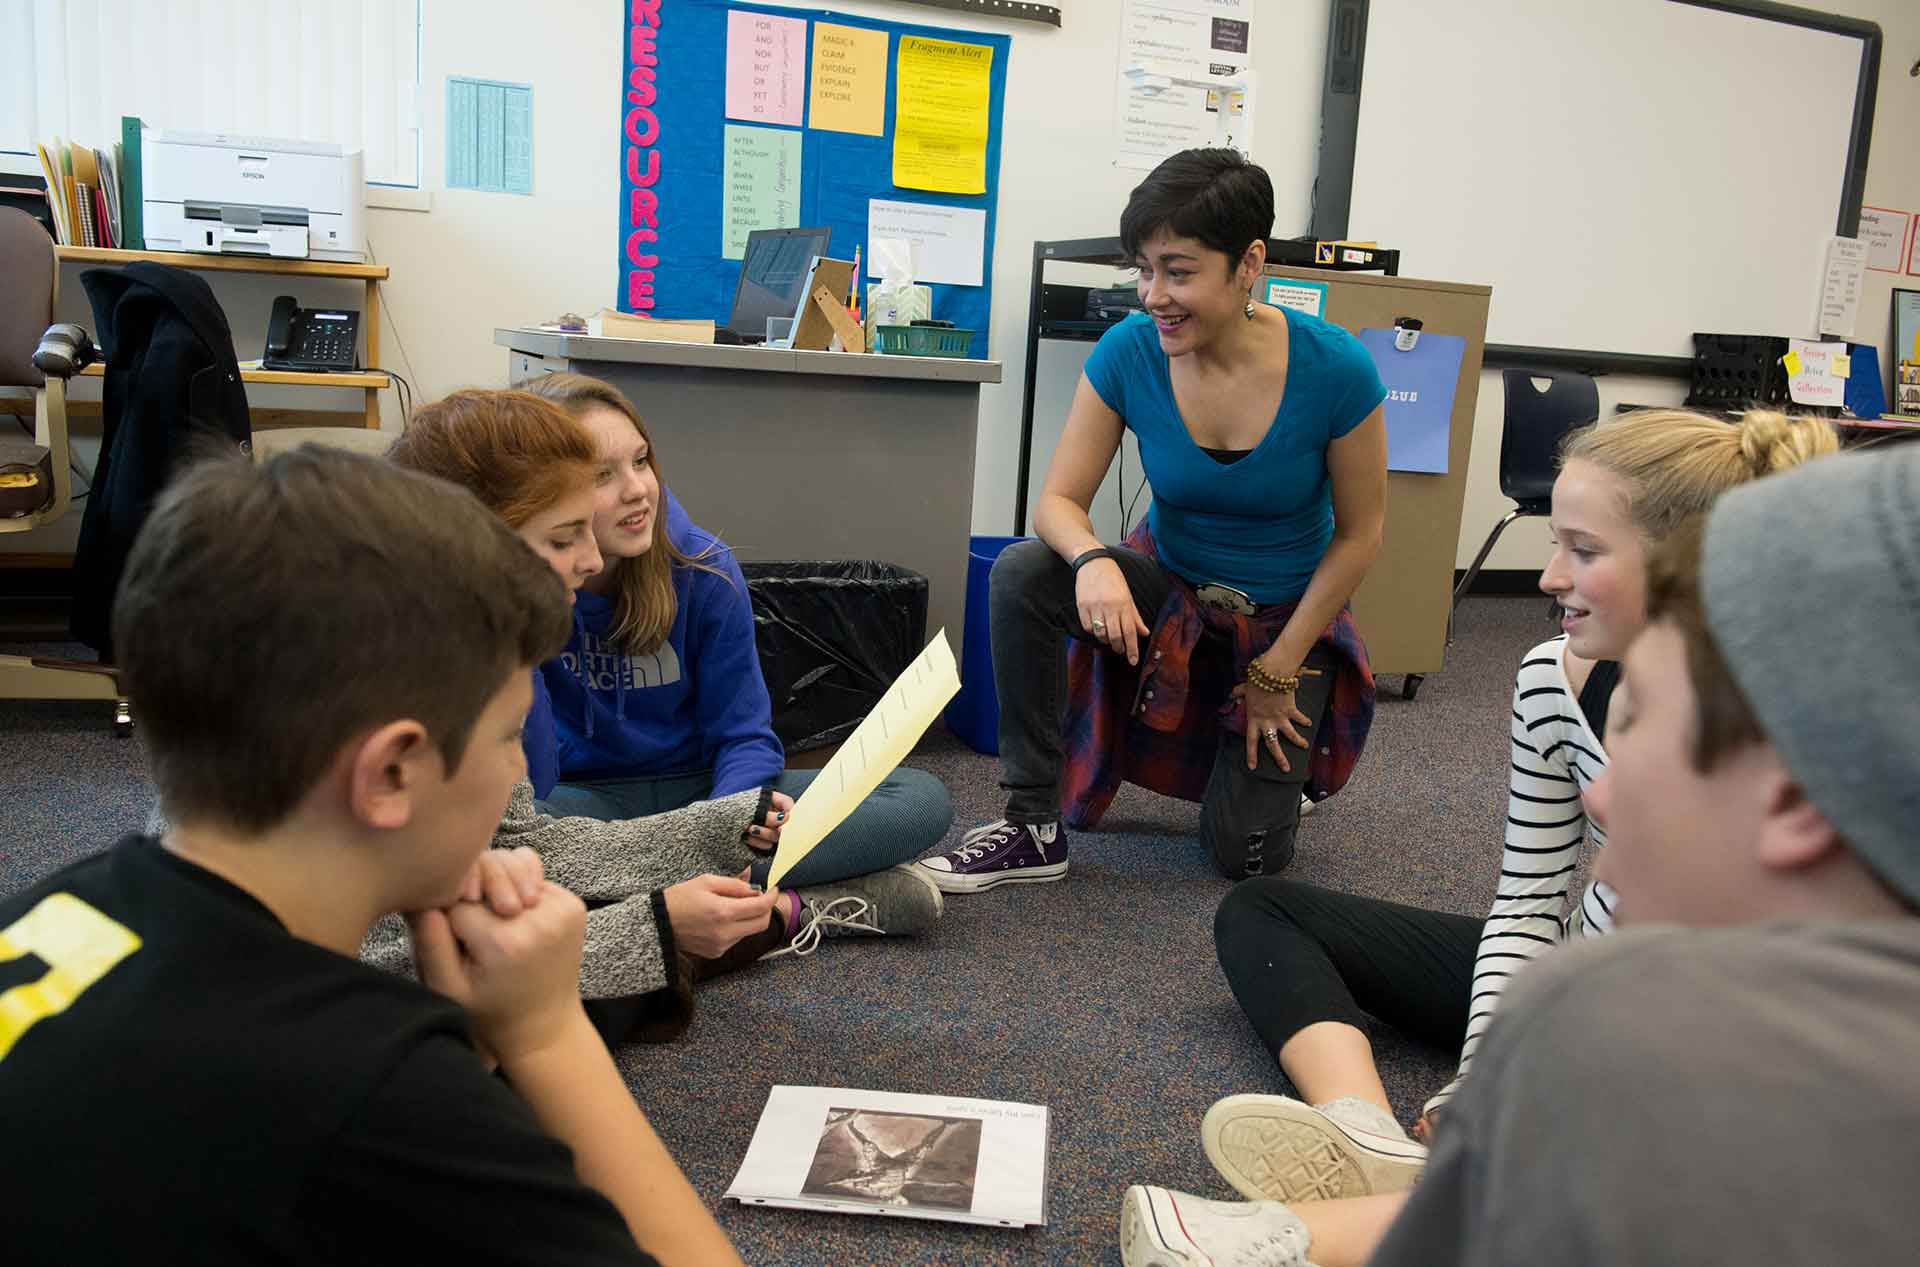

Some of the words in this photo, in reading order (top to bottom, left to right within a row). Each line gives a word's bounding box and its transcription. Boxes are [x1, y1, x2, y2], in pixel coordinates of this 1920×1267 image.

[755, 21, 771, 30] FOR
[756, 36, 773, 45] AND
[910, 39, 957, 57] Fragment
[959, 47, 984, 58] Alert
[754, 49, 772, 58] NOR
[822, 49, 845, 58] CLAIM
[753, 63, 769, 72] BUT
[820, 63, 857, 75] EVIDENCE
[753, 77, 765, 85] OR
[819, 77, 851, 89] EXPLAIN
[753, 91, 768, 100] YET
[819, 91, 852, 102] EXPLORE
[753, 105, 764, 113] SO
[733, 137, 754, 145] AFTER
[733, 148, 769, 158] ALTHOUGH
[624, 0, 661, 320] RESOURCE
[241, 171, 265, 180] EPSON
[733, 172, 753, 180] WHEN
[732, 206, 756, 215] BEFORE
[732, 216, 761, 226] BECAUSE
